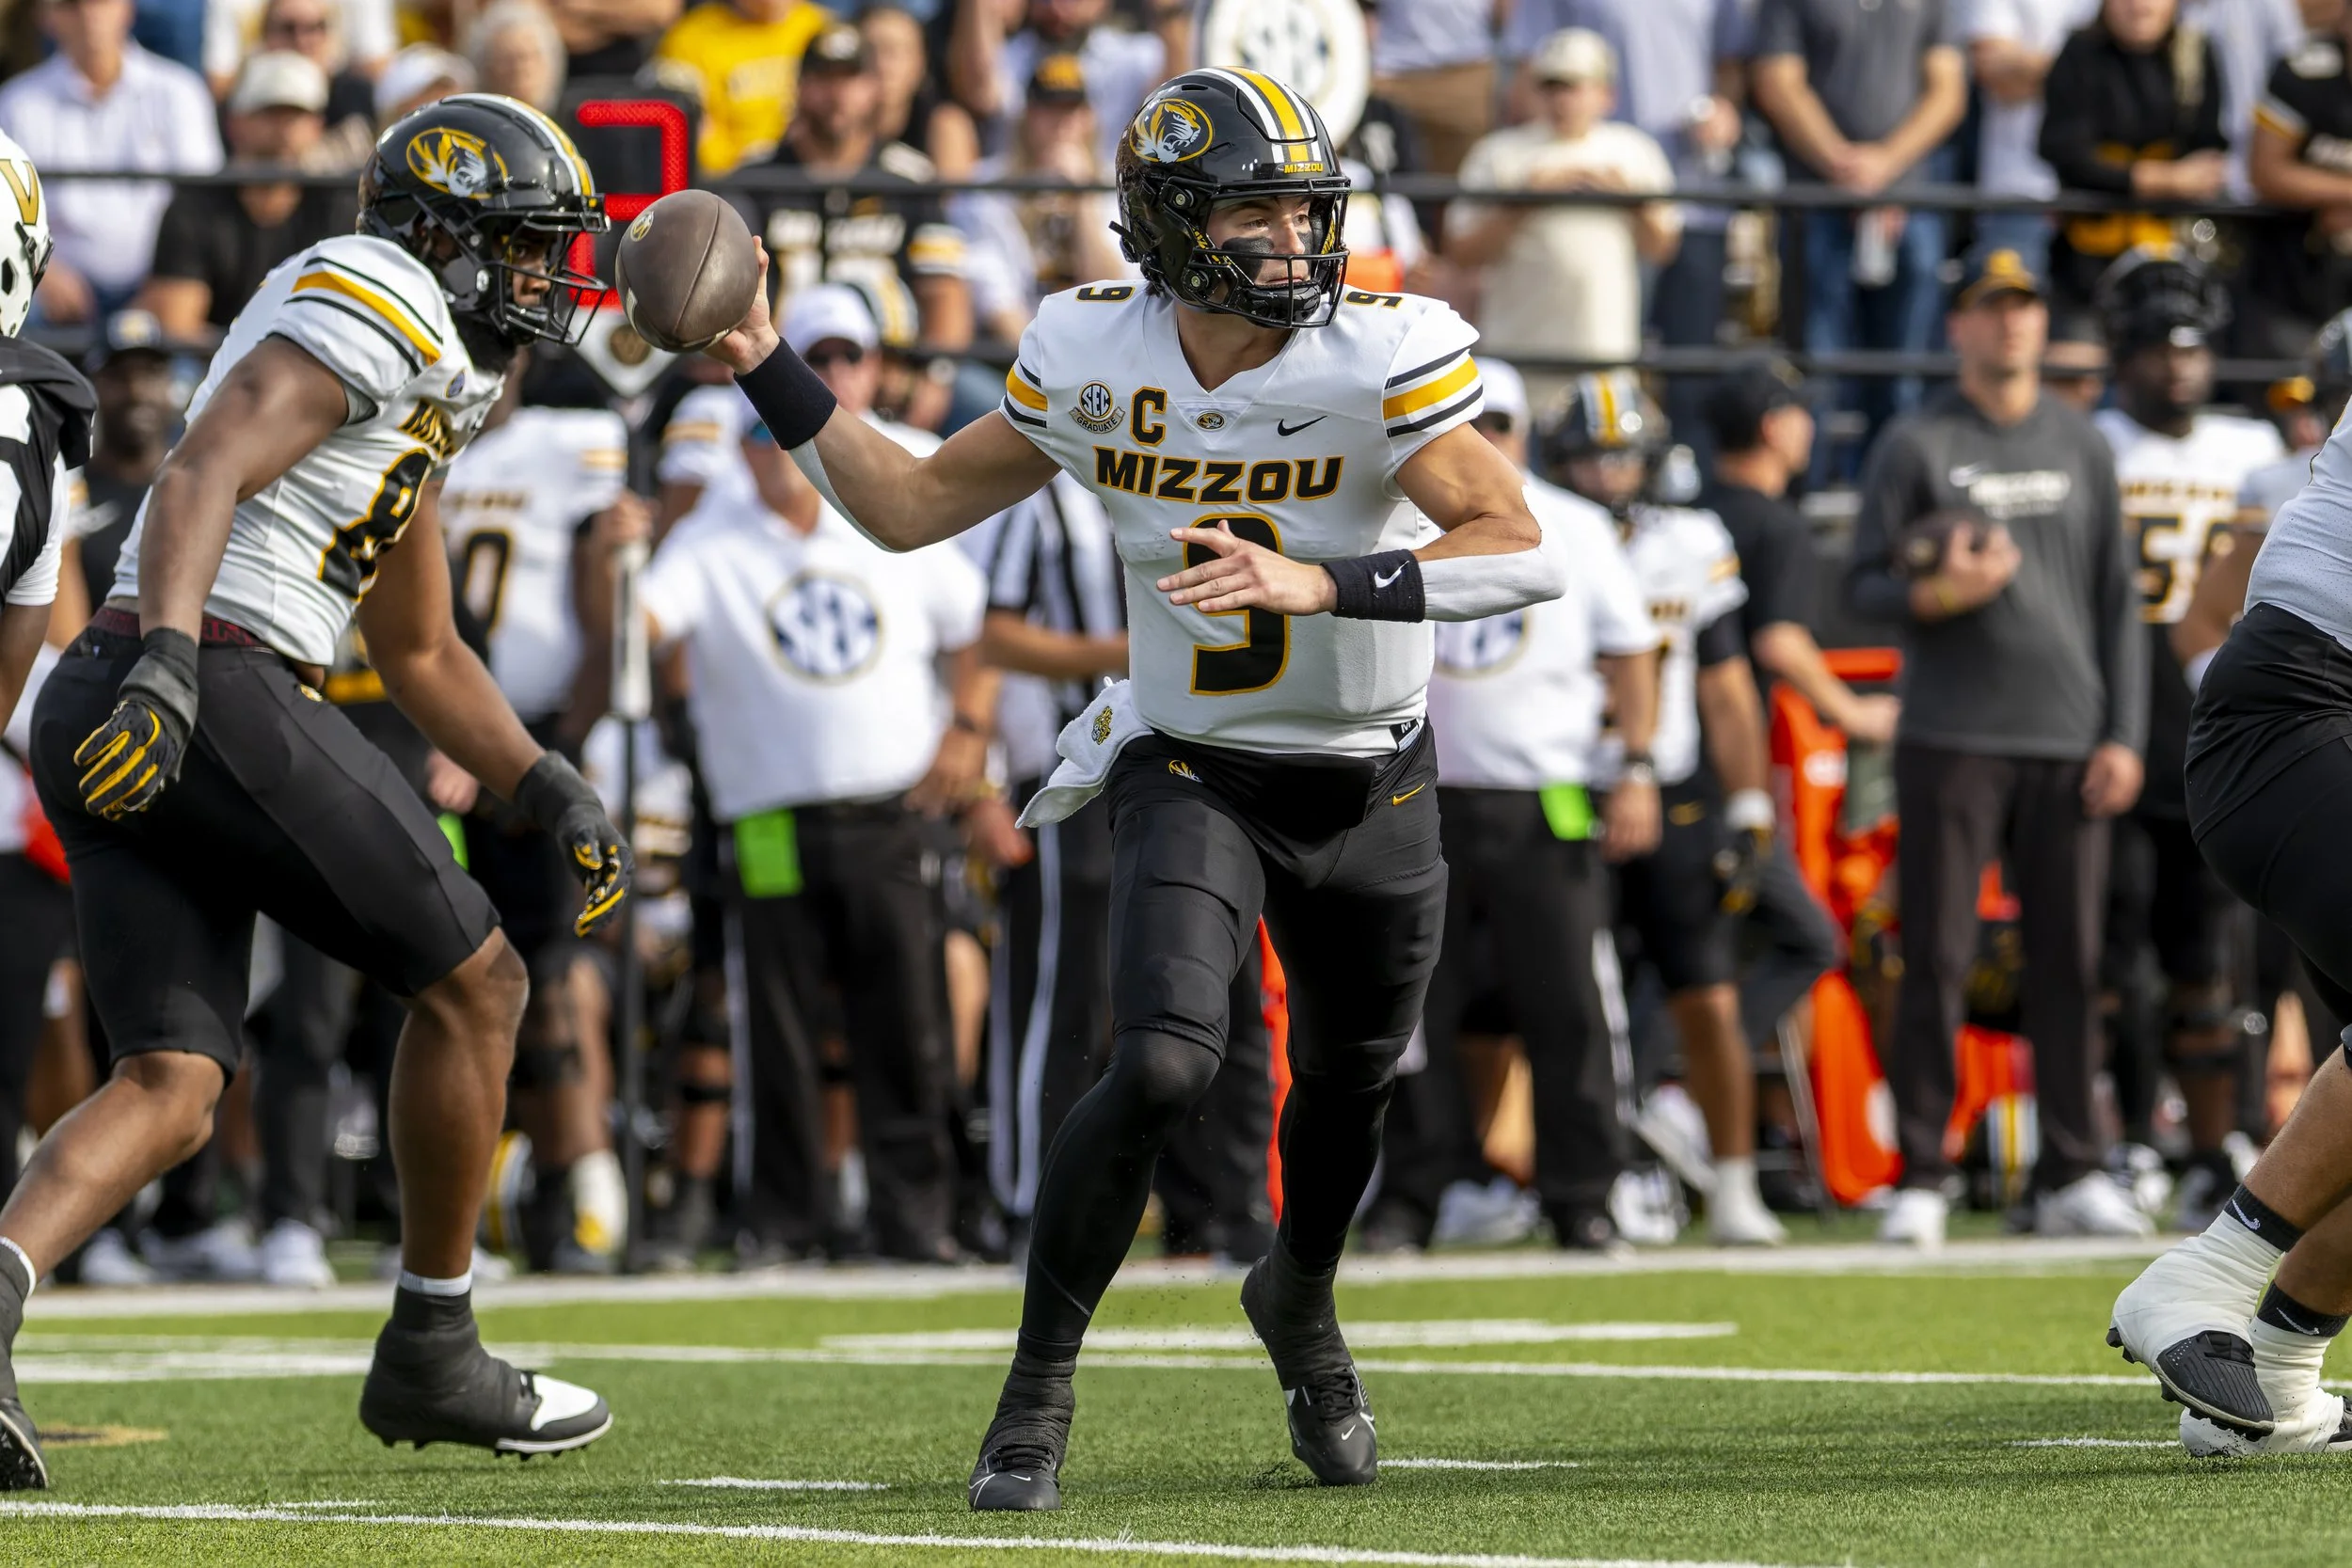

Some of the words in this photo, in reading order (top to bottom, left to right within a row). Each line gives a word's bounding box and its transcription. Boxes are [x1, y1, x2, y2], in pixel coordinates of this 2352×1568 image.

[1284, 162, 1324, 174] MIZZOU
[1075, 286, 1136, 303] 9
[1343, 291, 1404, 309] 9
[1081, 386, 1110, 417] SEC
[1076, 417, 1118, 433] GRADUATE
[1130, 386, 1168, 447] C
[1092, 445, 1344, 504] MIZZOU
[1182, 511, 1290, 697] 9
